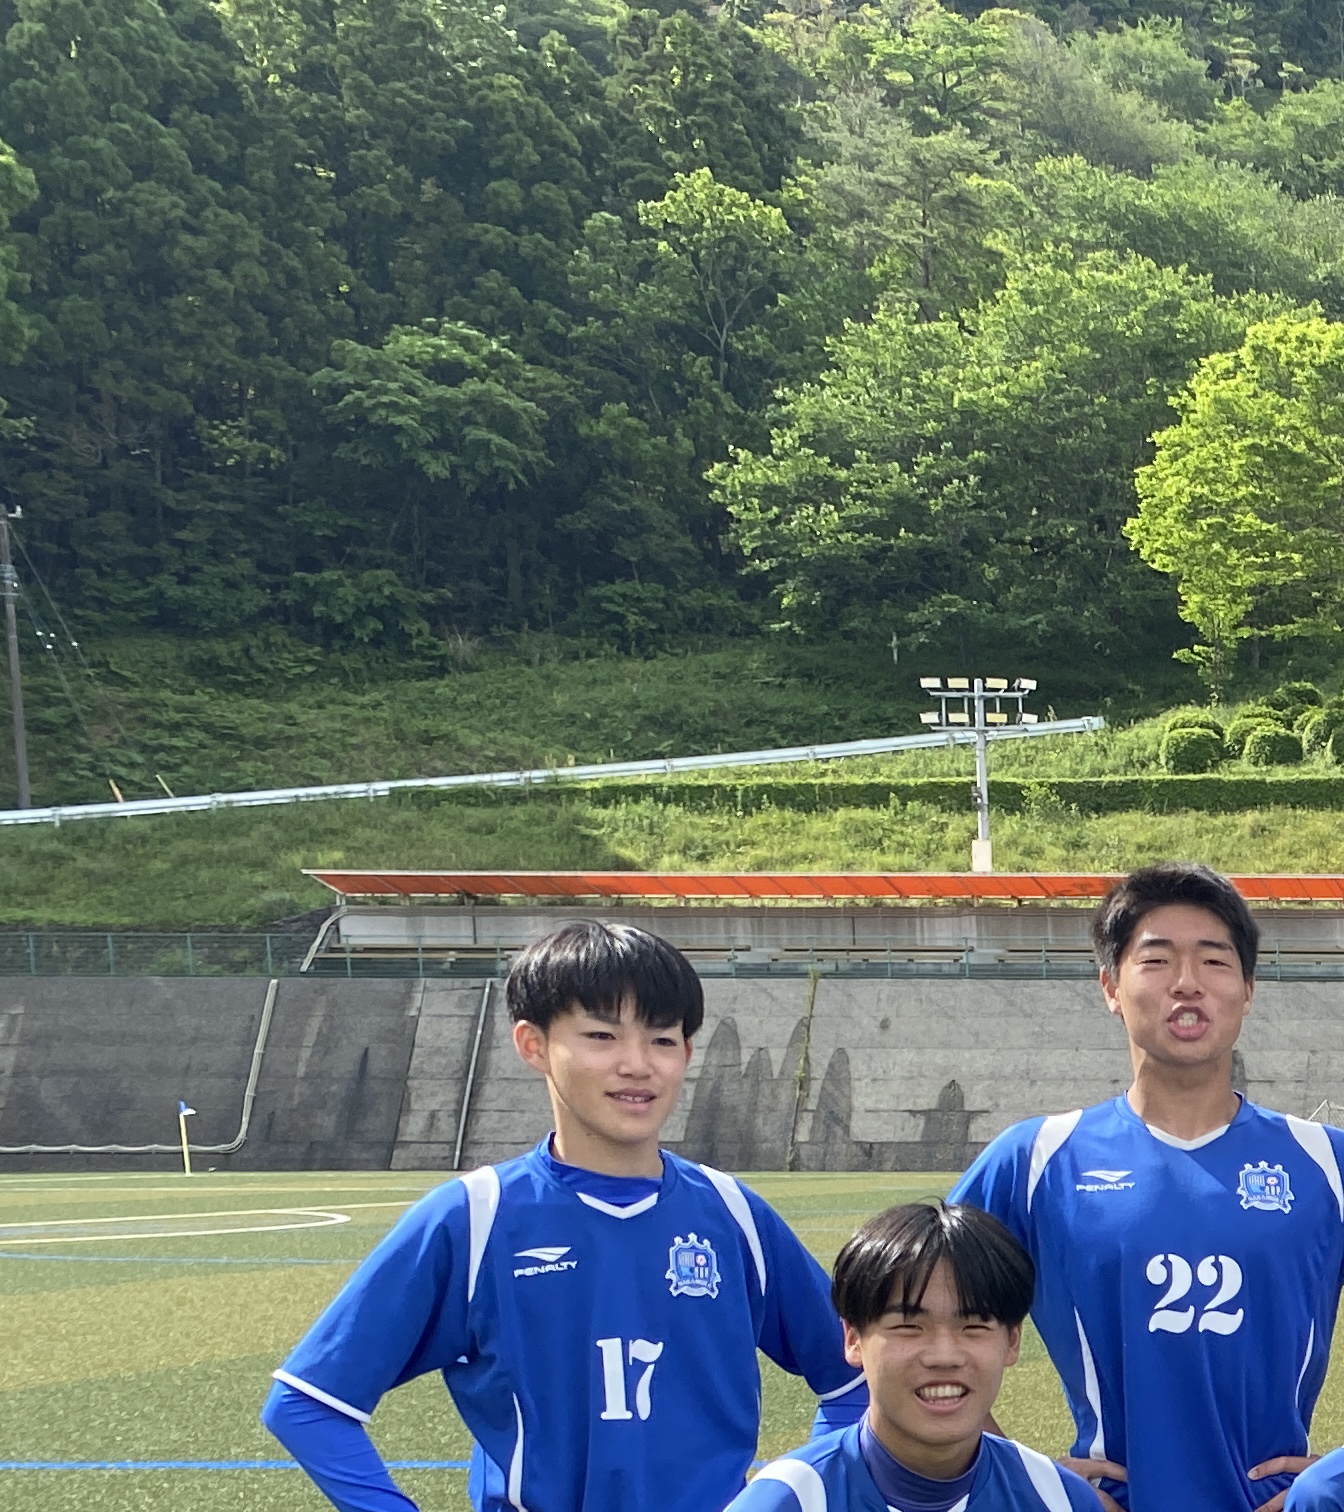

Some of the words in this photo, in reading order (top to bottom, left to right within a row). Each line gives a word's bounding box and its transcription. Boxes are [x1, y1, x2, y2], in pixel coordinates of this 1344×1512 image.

[1076, 1182, 1136, 1192] PENALTY
[513, 1260, 578, 1278] PENALTY
[1146, 1253, 1244, 1336] 22
[596, 1337, 664, 1421] 17
